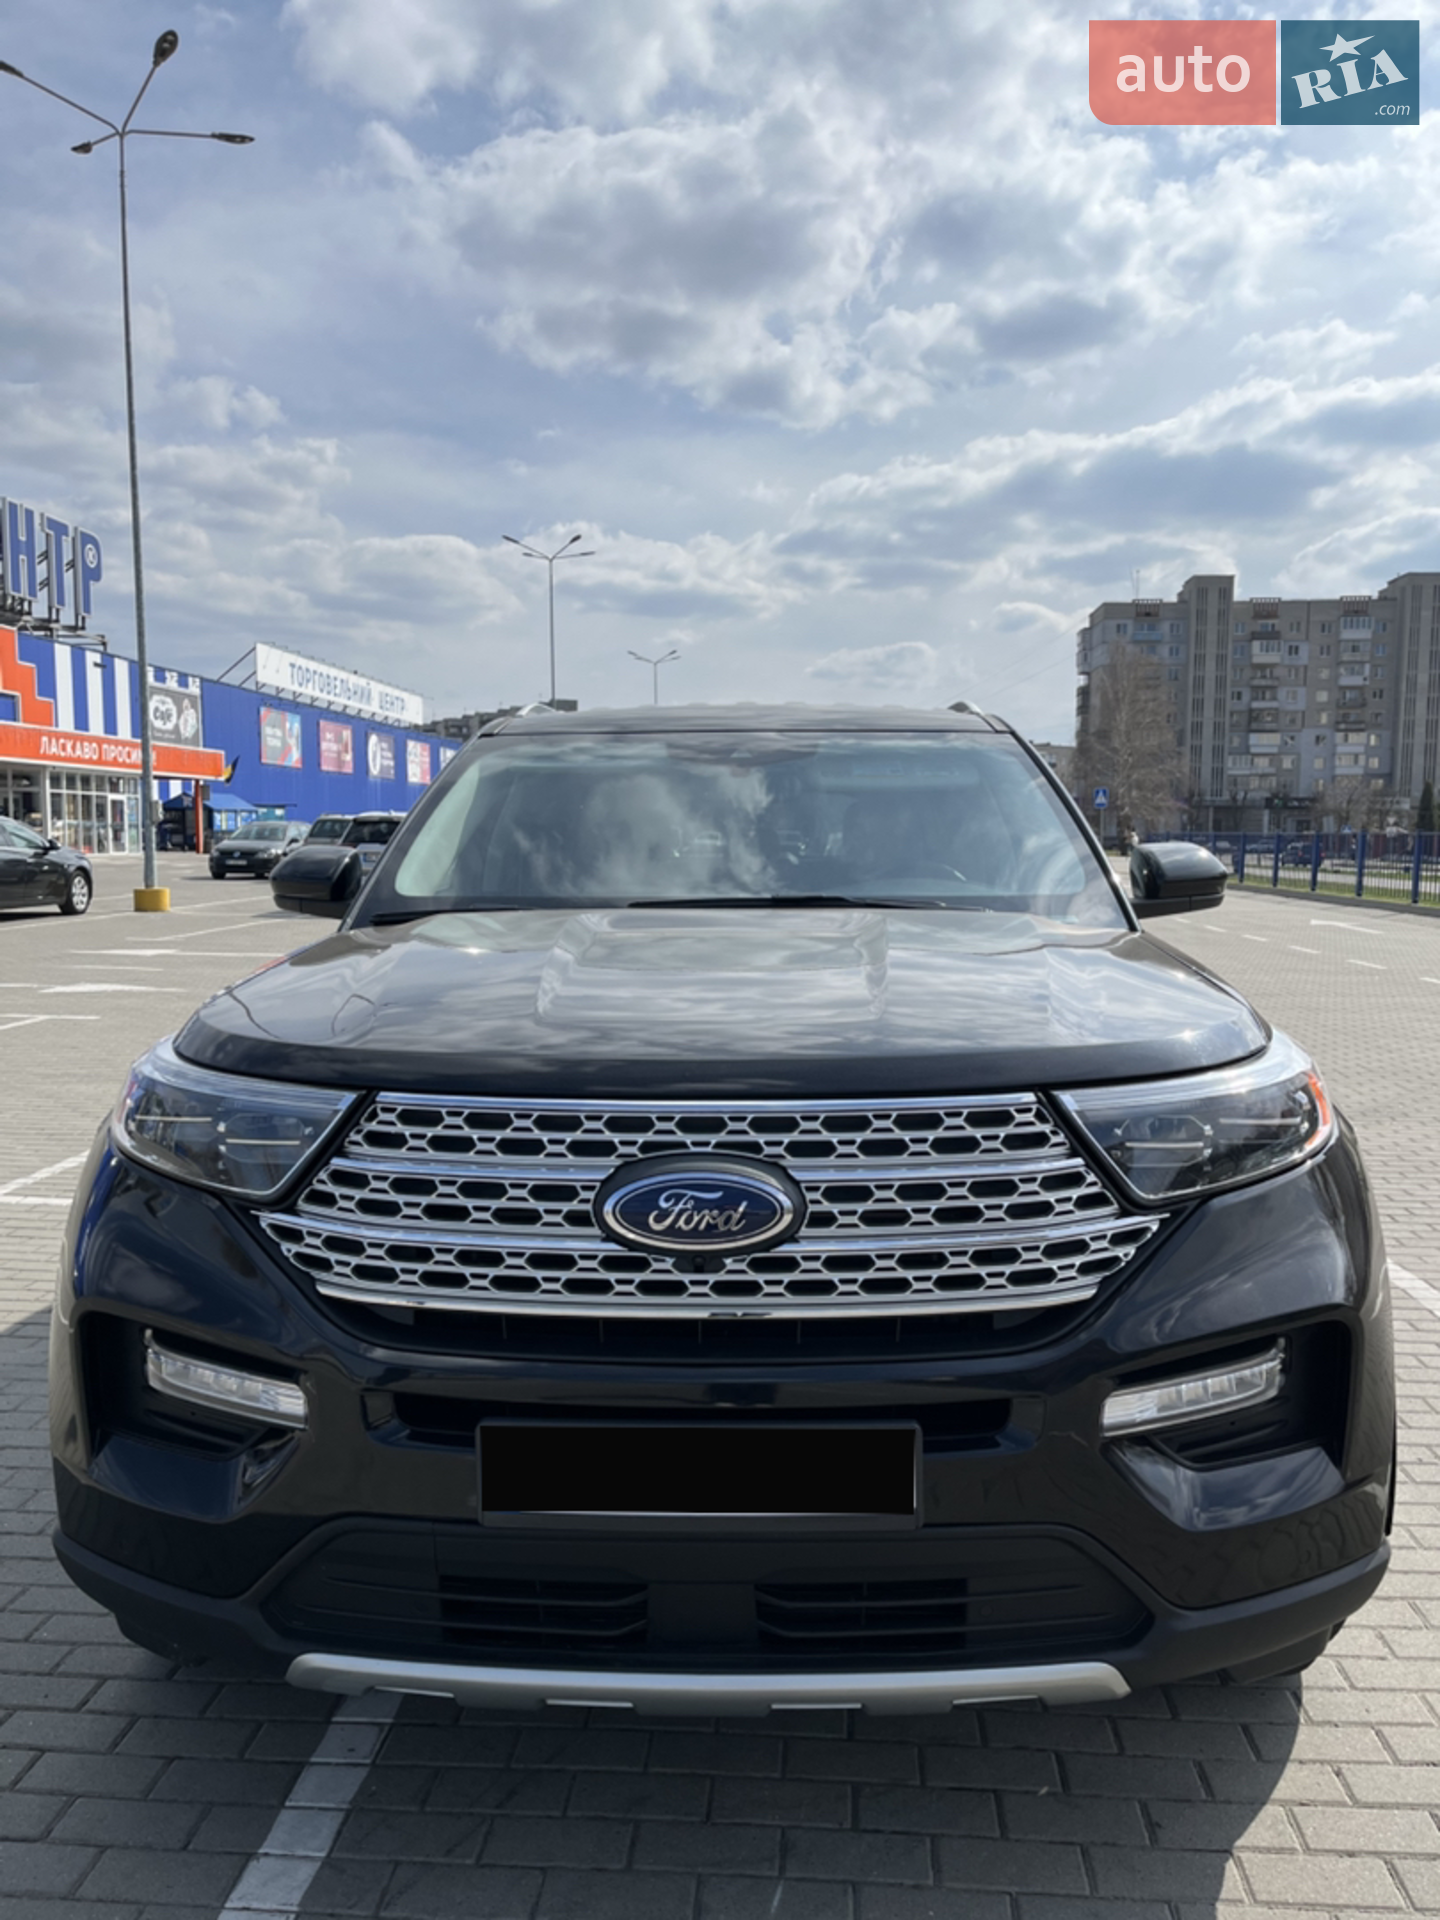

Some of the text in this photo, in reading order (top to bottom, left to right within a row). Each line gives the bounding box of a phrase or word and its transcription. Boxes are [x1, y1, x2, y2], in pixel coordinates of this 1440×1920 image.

[288, 662, 406, 716] ТОРГОВЕЛЬНИЙ ЦЕНТР
[39, 736, 100, 761] ЛАСКАВО
[648, 1189, 748, 1232] Ford
